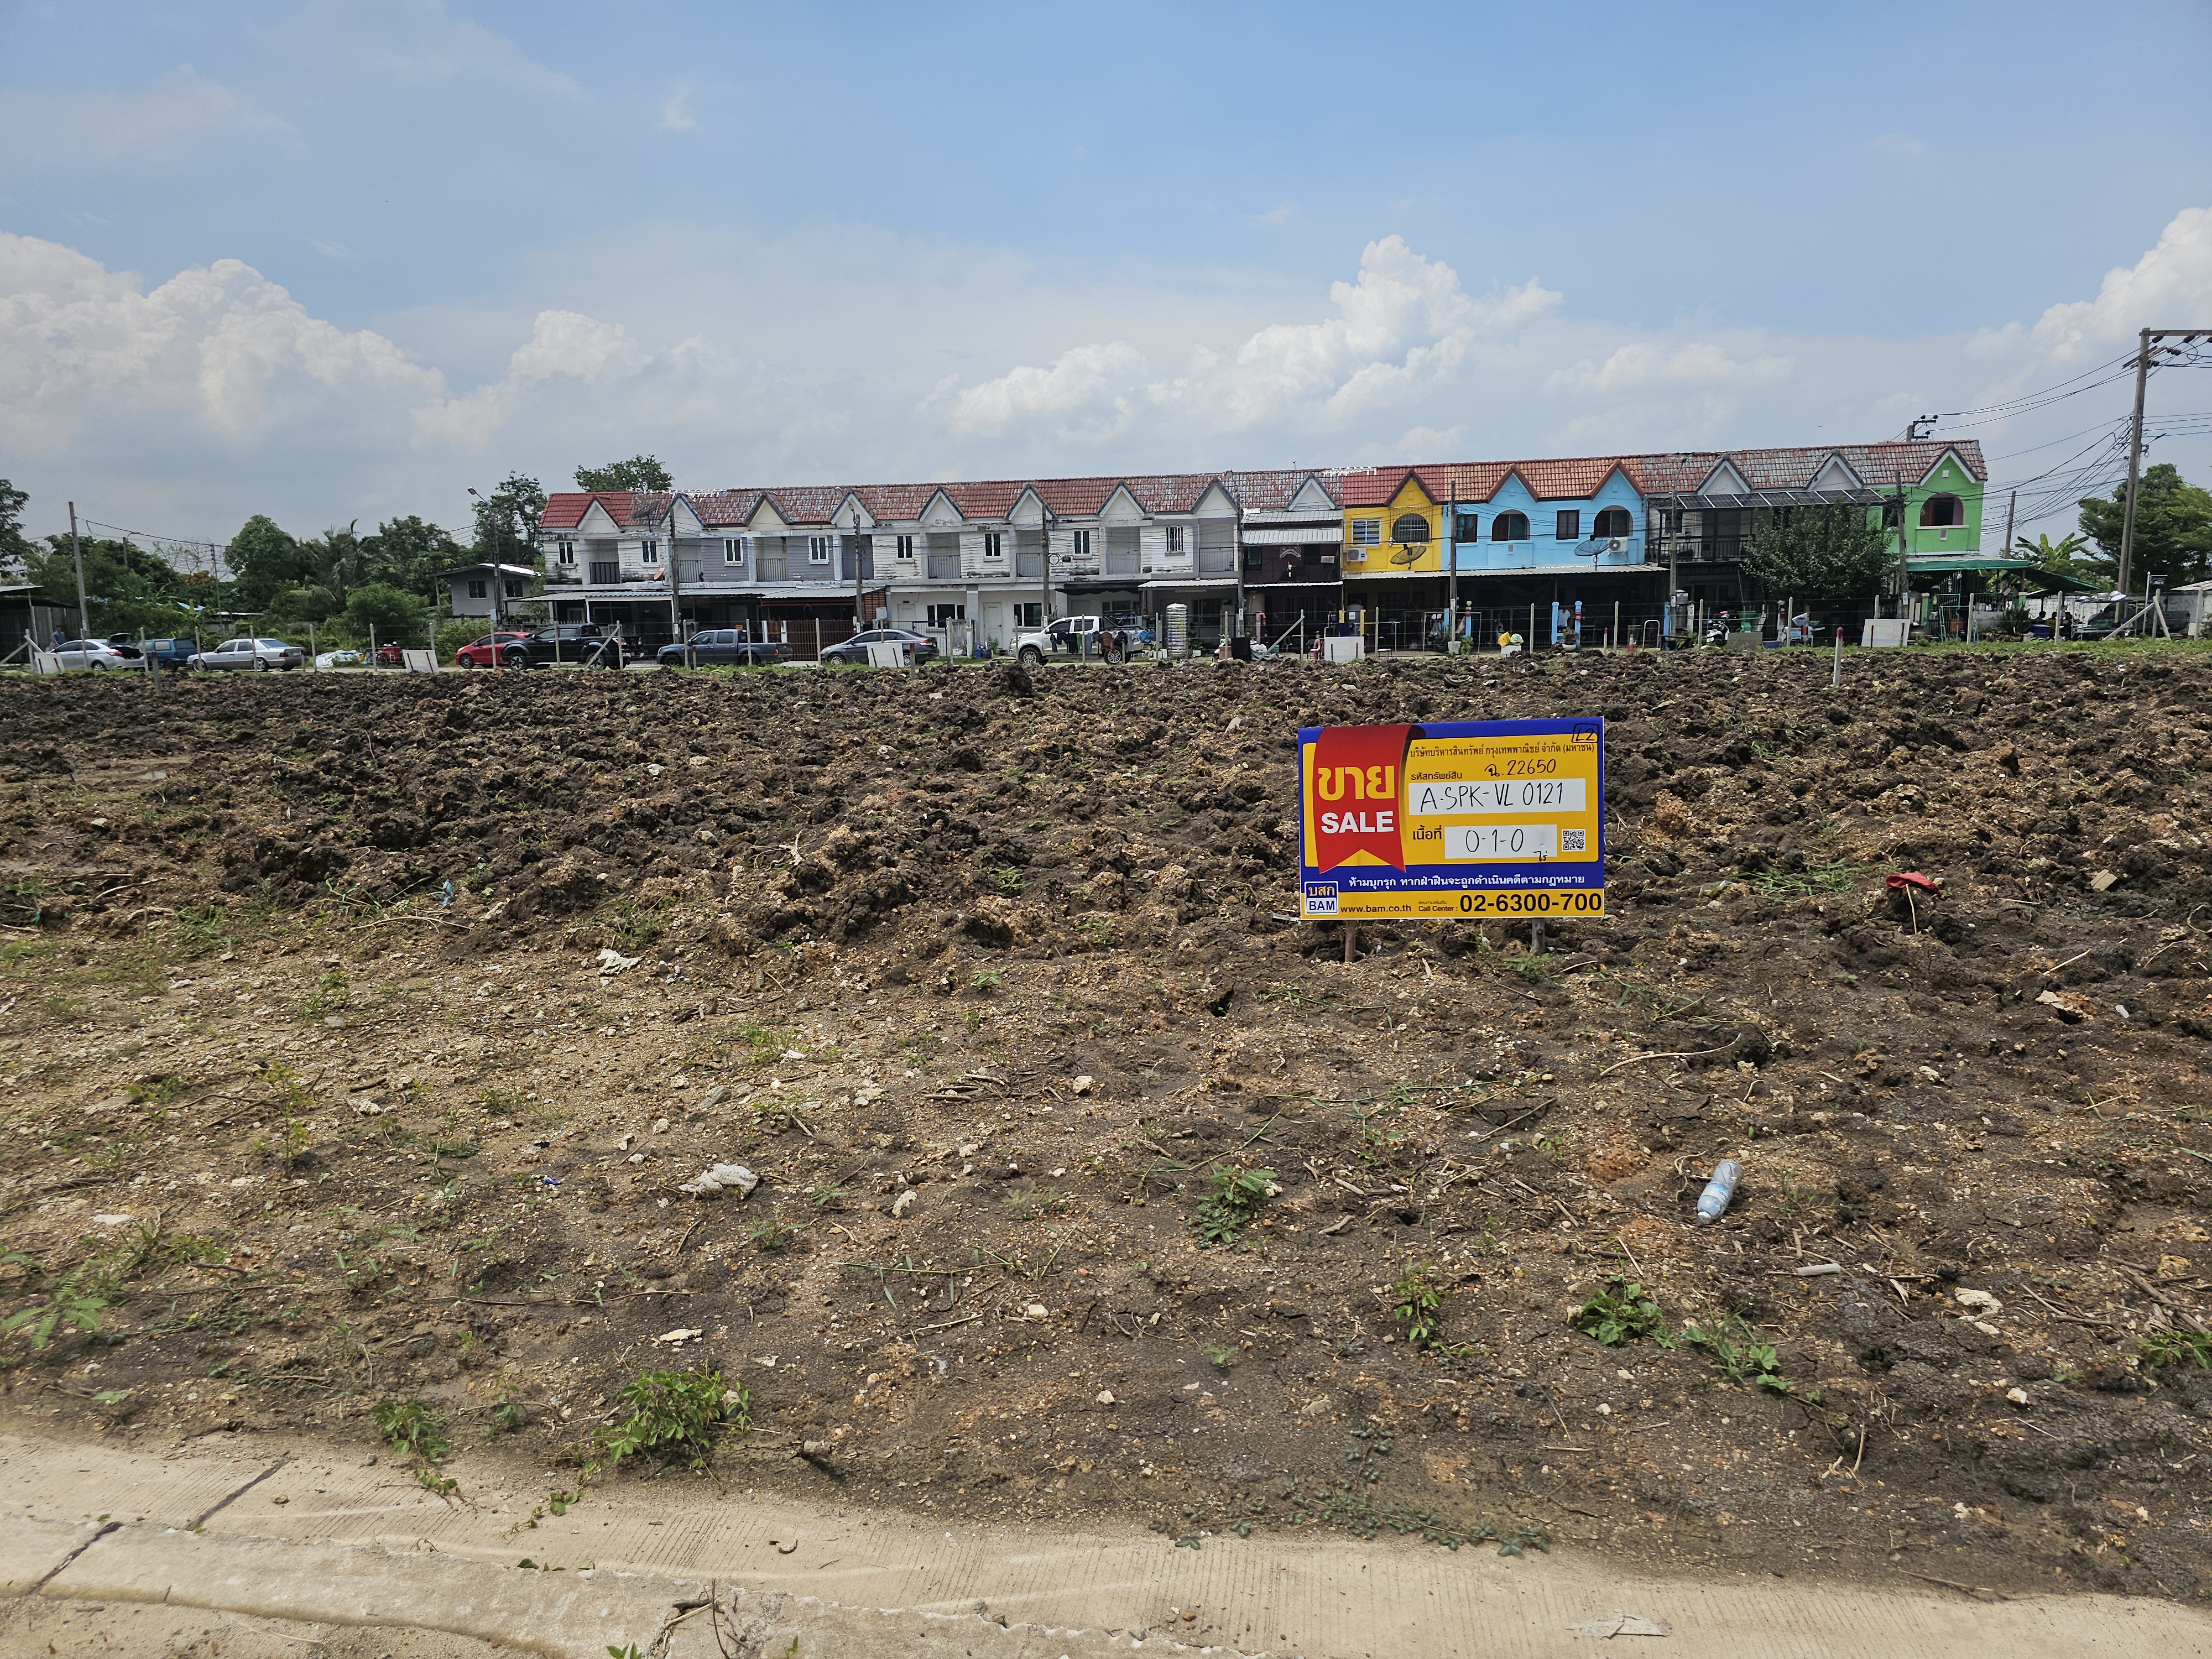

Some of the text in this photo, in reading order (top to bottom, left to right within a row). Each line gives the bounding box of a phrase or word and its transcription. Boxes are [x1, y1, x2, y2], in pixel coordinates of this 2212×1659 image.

[1410, 742, 1594, 758] บริษัทบริหารสินทรัพย์ กรุงเทพพาณิชย์ จำกัด (มหาชน)
[1318, 765, 1395, 801] ขาย
[1411, 771, 1463, 780] รหัสทรัพย์สิน
[1522, 782, 1563, 806] 0121
[1321, 811, 1394, 834] SALE
[1413, 825, 1442, 841] เนื้อที่
[1308, 886, 1335, 897] บสก
[1348, 877, 1396, 890] ห้ามบุกรุก
[1309, 900, 1335, 911] BAM
[1340, 904, 1411, 913] www.bam.co.th
[1460, 893, 1602, 912] 02-6300-700
